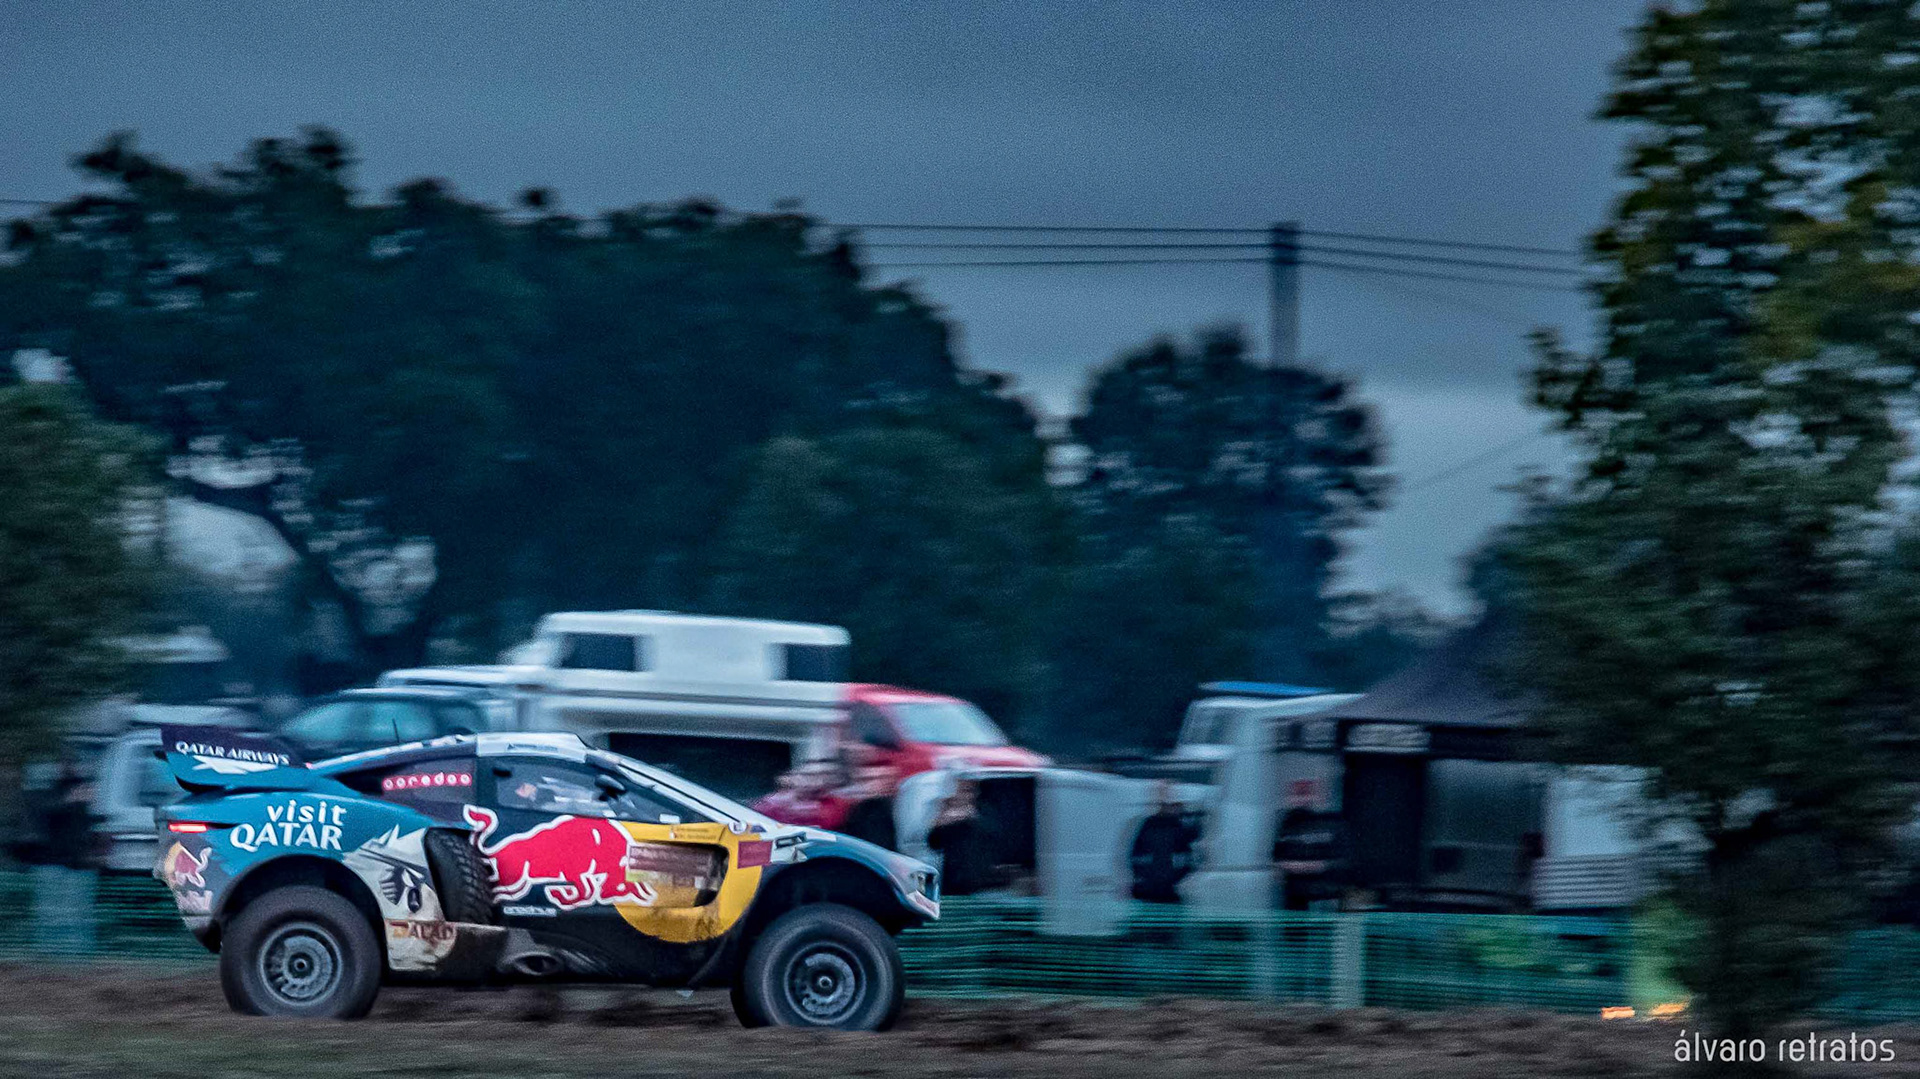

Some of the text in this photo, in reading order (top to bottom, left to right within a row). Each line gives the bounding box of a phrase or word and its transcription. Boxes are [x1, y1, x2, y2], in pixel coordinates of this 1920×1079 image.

[176, 741, 290, 765] QATAR AIRWAYS
[383, 772, 471, 790] ooredoo
[267, 800, 346, 825] visit
[229, 822, 342, 852] QATAR
